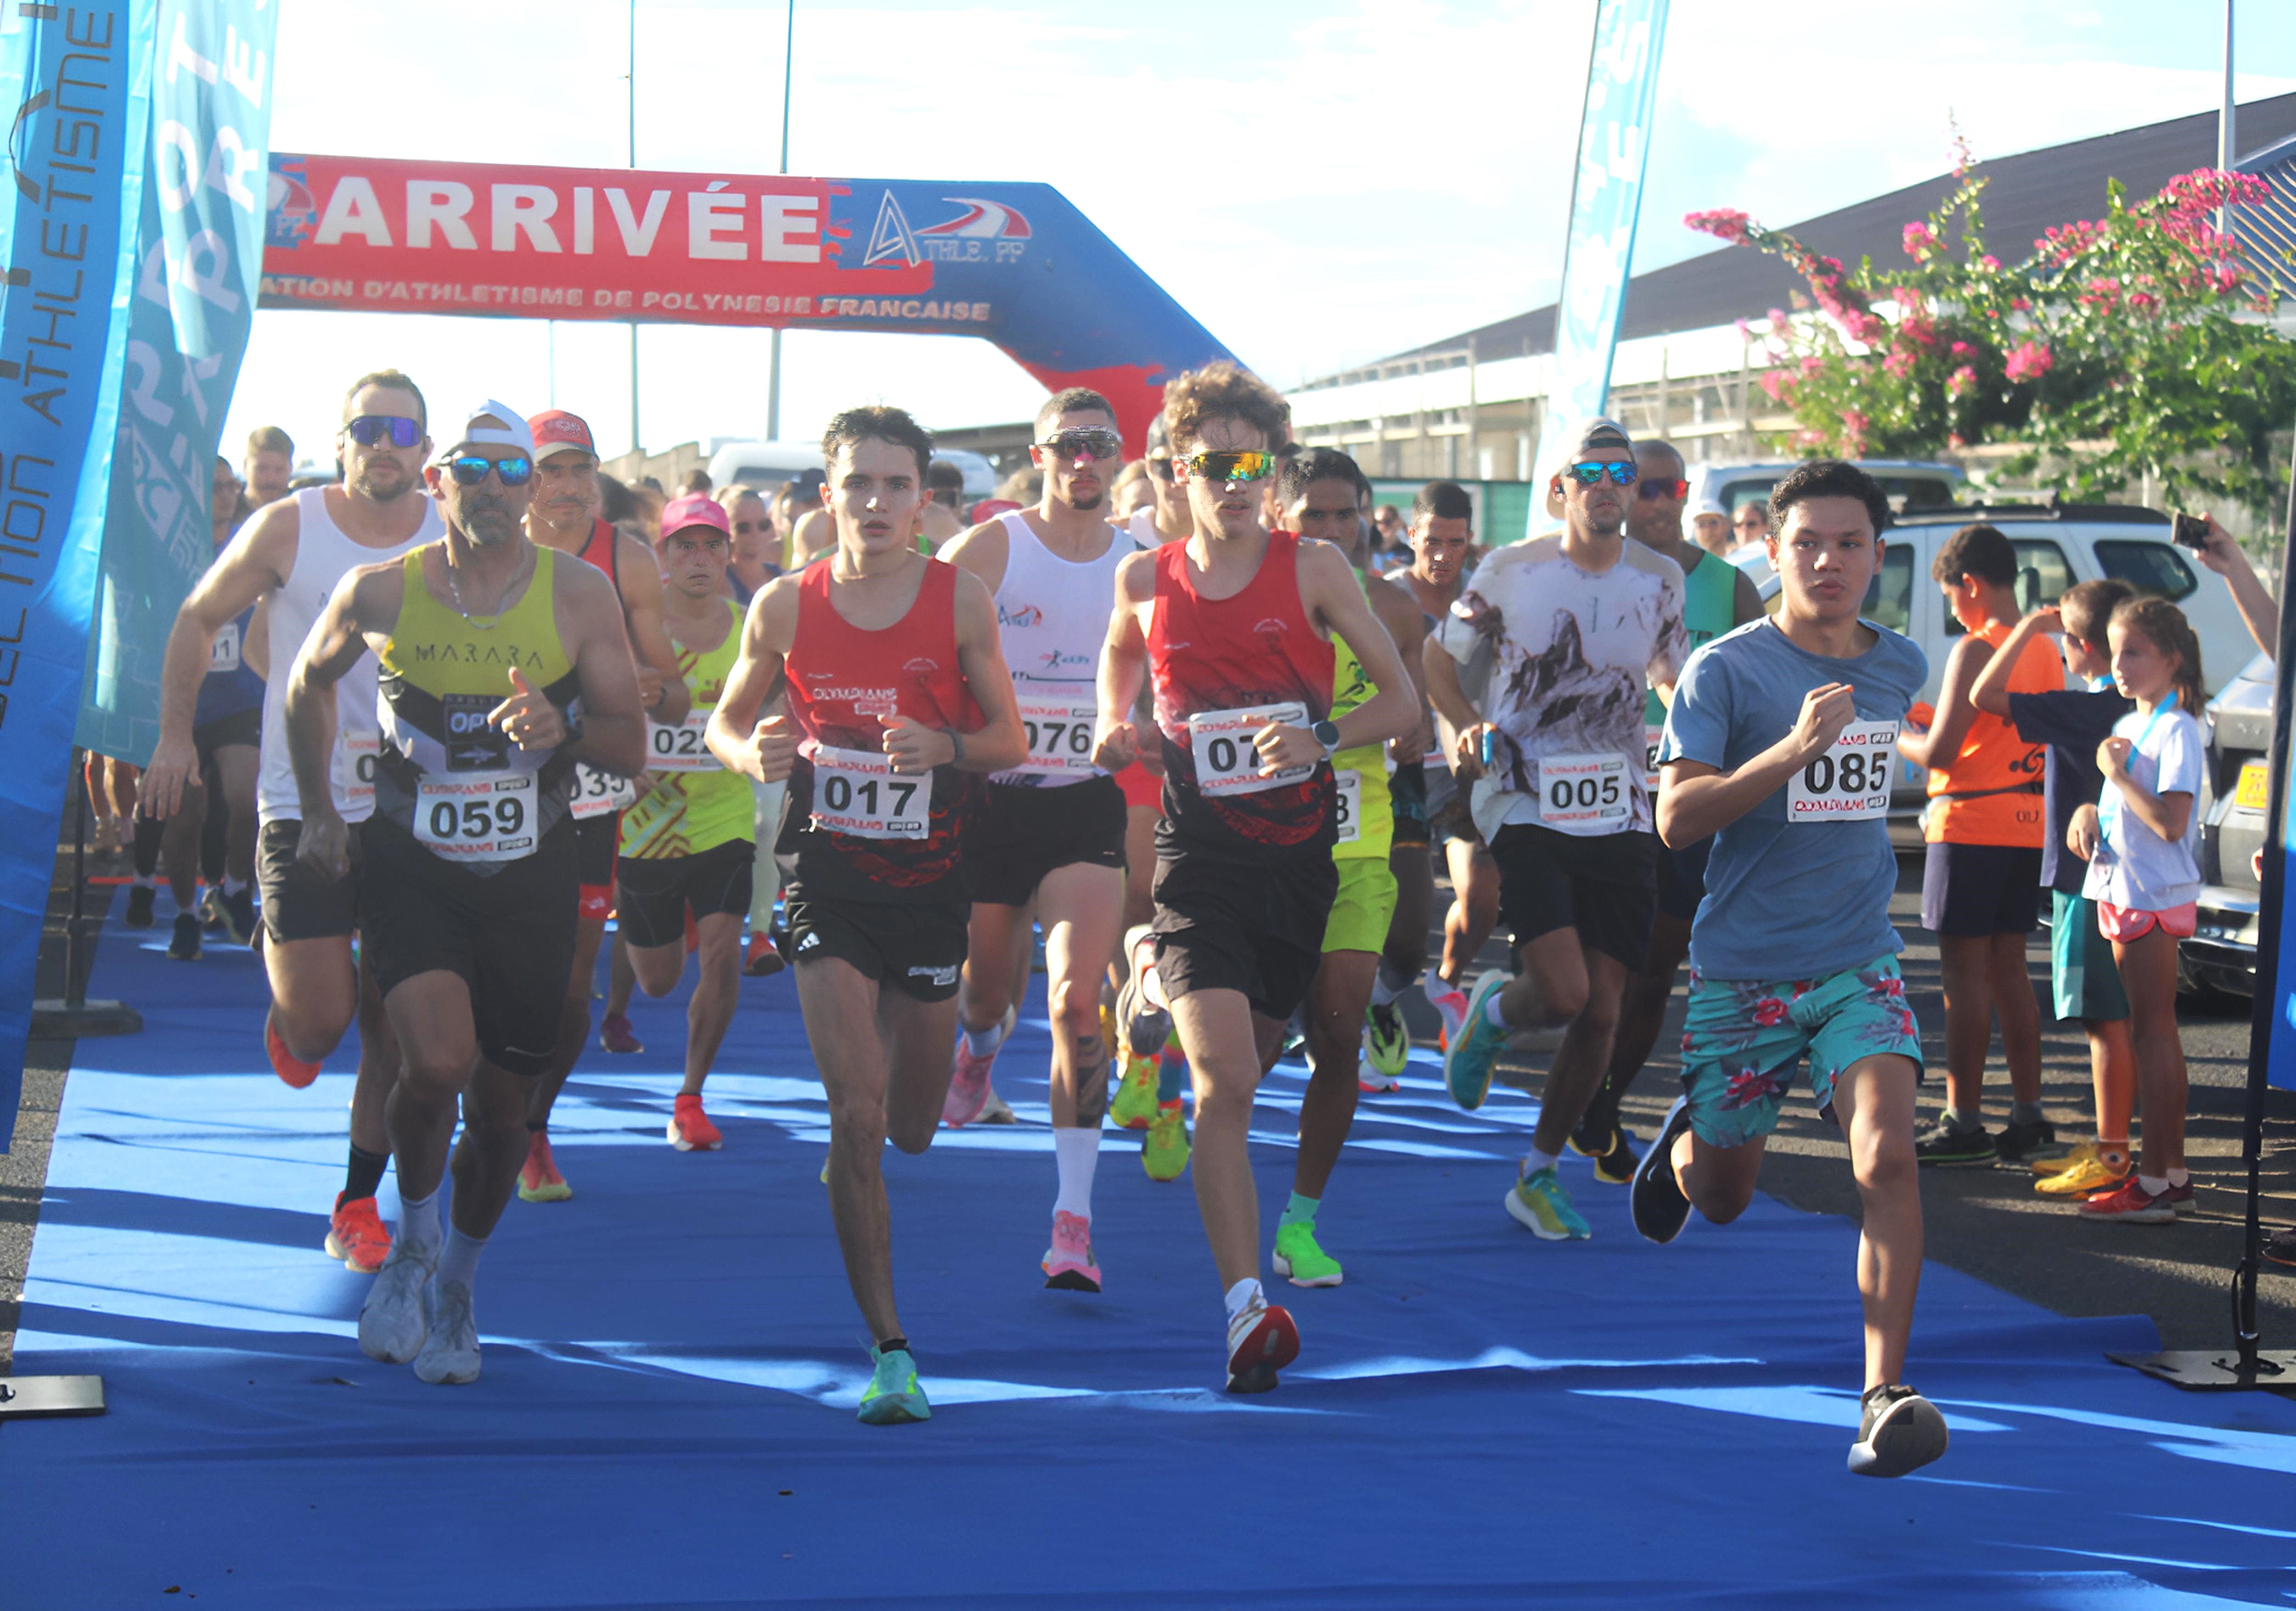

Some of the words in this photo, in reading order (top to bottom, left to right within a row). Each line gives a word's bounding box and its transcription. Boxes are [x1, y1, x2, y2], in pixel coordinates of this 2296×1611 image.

[22, 7, 114, 426] ATHLETISME
[314, 176, 821, 263] ARRIVÉE
[363, 280, 583, 307] D'ATHLETISME
[594, 289, 632, 307] DE
[643, 292, 811, 314] POLYNESIE
[821, 298, 991, 321] FRANCAISE
[1551, 776, 1619, 809] 005
[1805, 752, 1888, 794] 085
[825, 776, 917, 817] 017
[430, 797, 525, 839] 059
